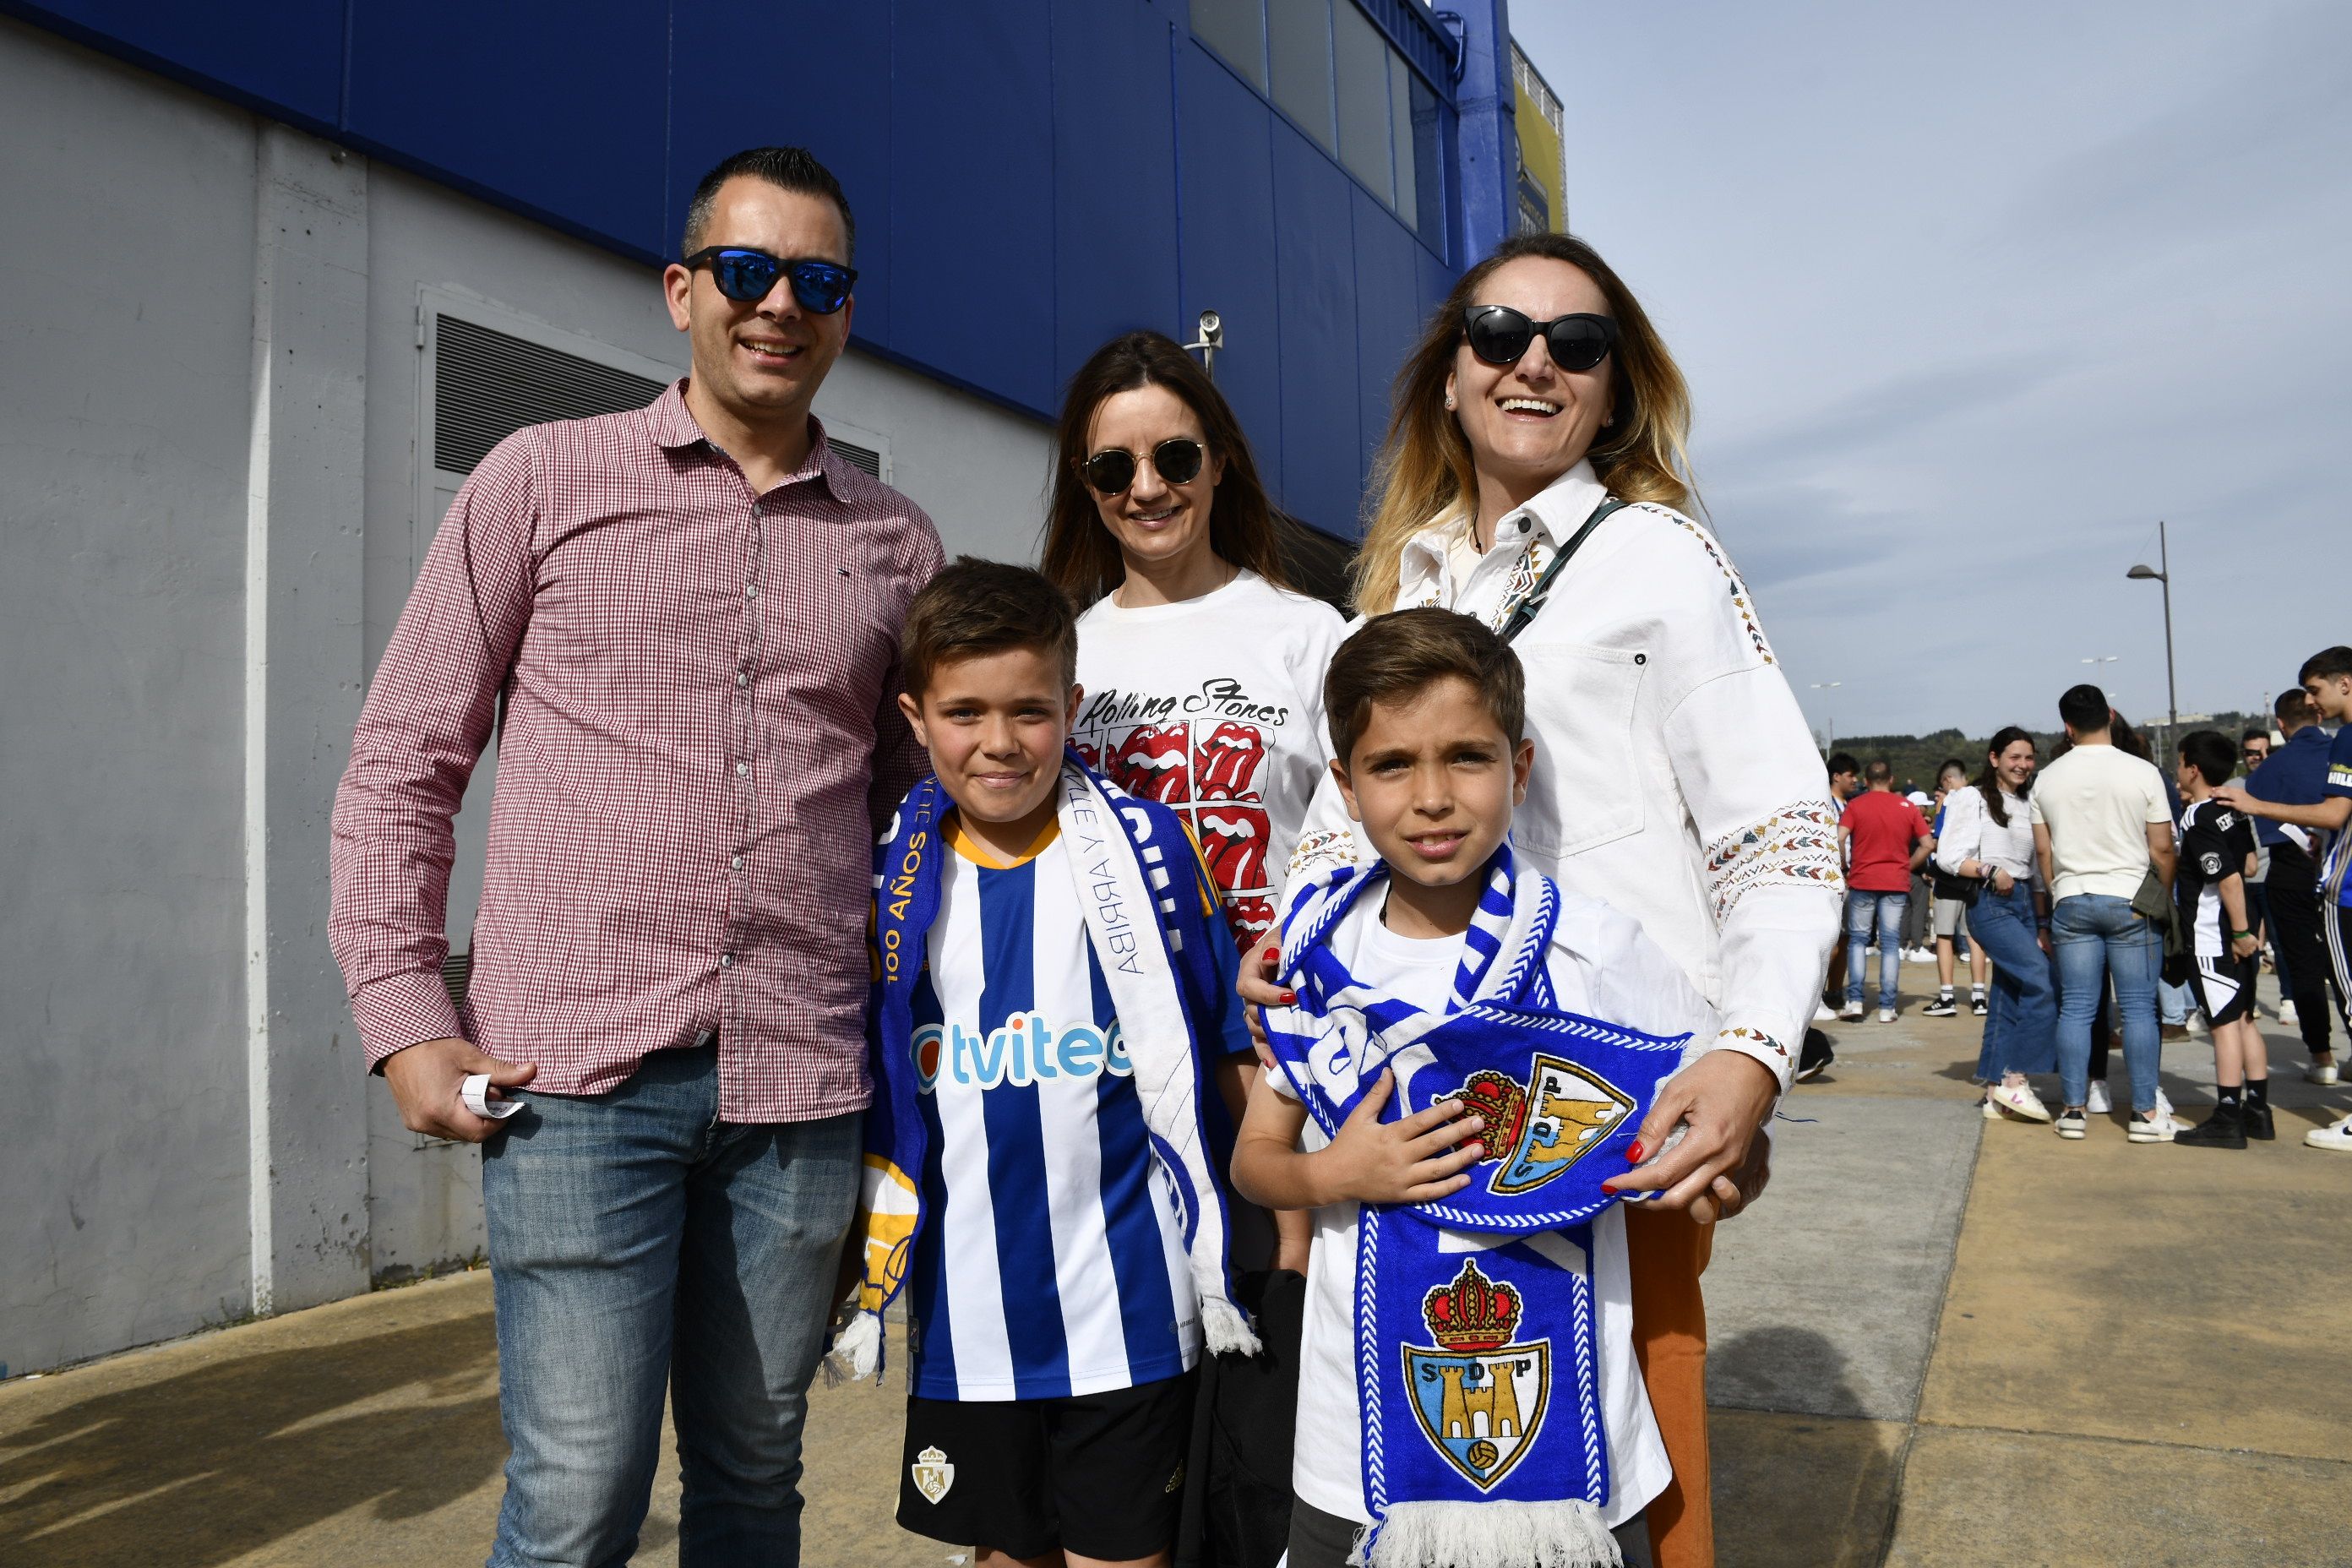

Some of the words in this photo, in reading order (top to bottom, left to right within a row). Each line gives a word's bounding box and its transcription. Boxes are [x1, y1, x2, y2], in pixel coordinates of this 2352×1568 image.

[1079, 688, 1177, 738] Rolling
[1183, 678, 1288, 727] Stones
[889, 831, 927, 921] AÑOS
[885, 929, 901, 985] 100
